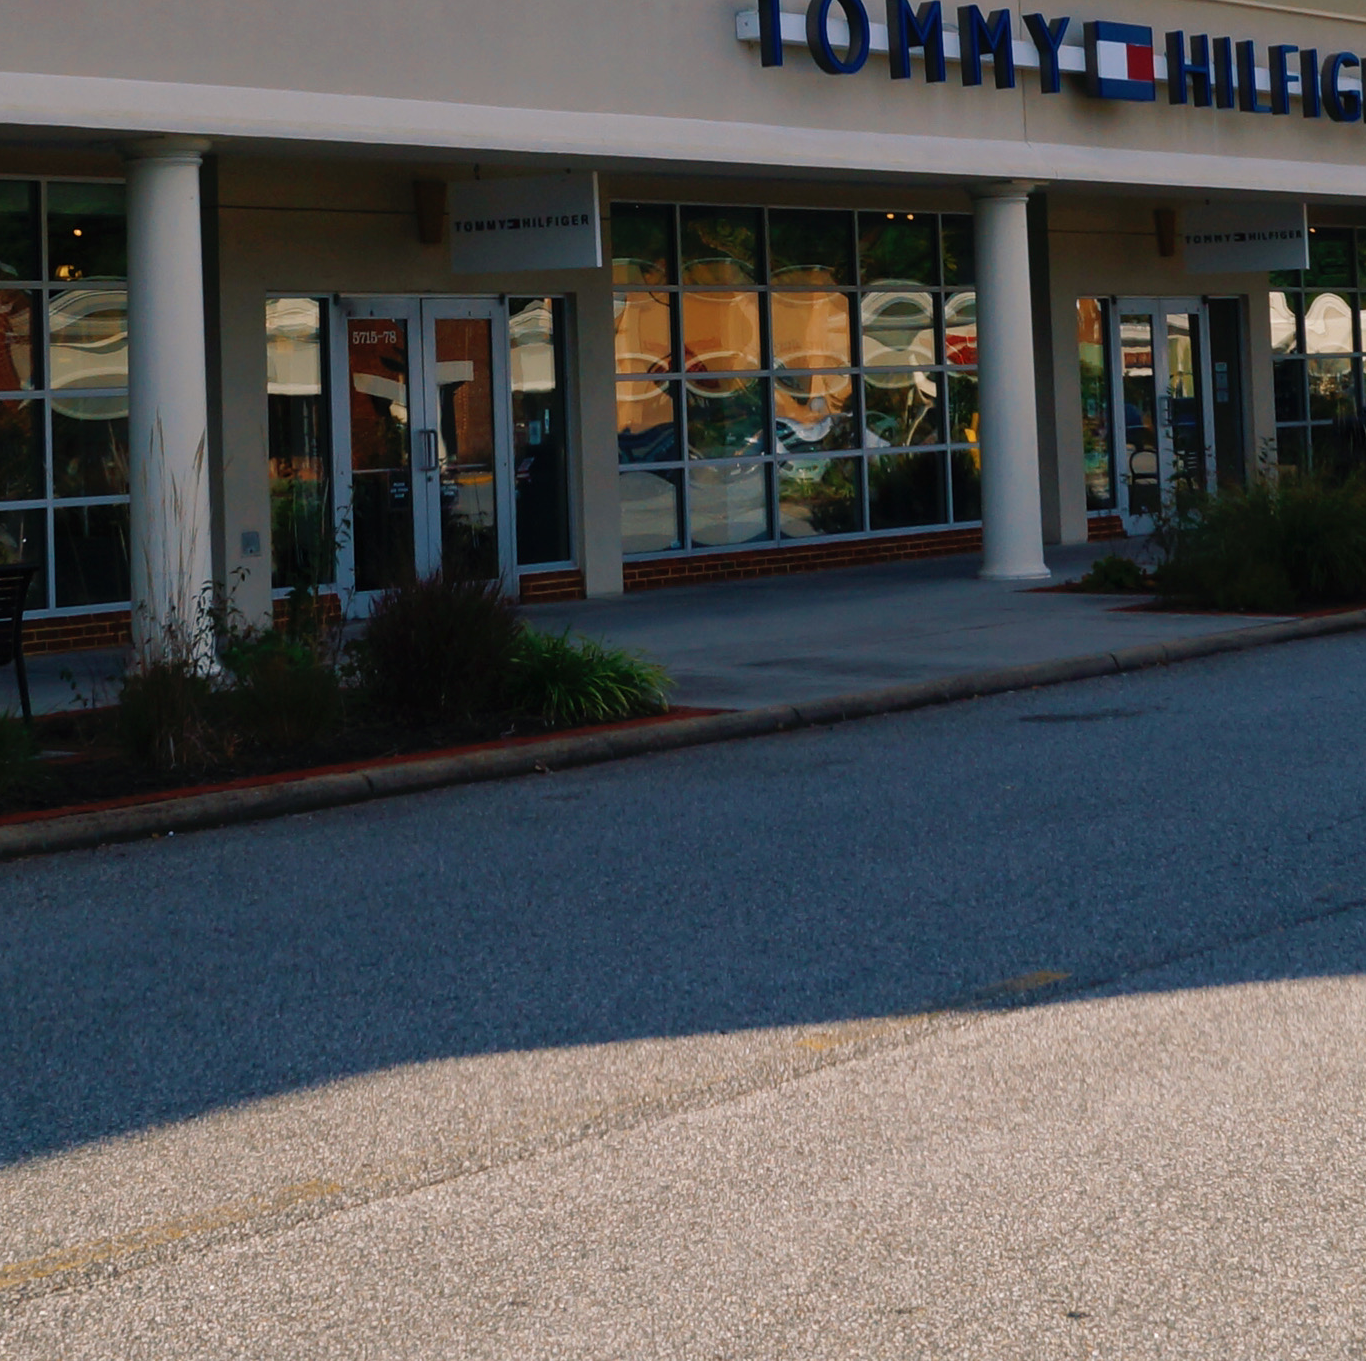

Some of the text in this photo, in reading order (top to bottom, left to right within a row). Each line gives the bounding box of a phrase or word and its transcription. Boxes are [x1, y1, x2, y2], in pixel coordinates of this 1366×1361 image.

[455, 214, 589, 232] TOMMY HILFIGER
[1185, 230, 1302, 244] TOMMY HILFIGER
[352, 330, 397, 345] 5715-78
